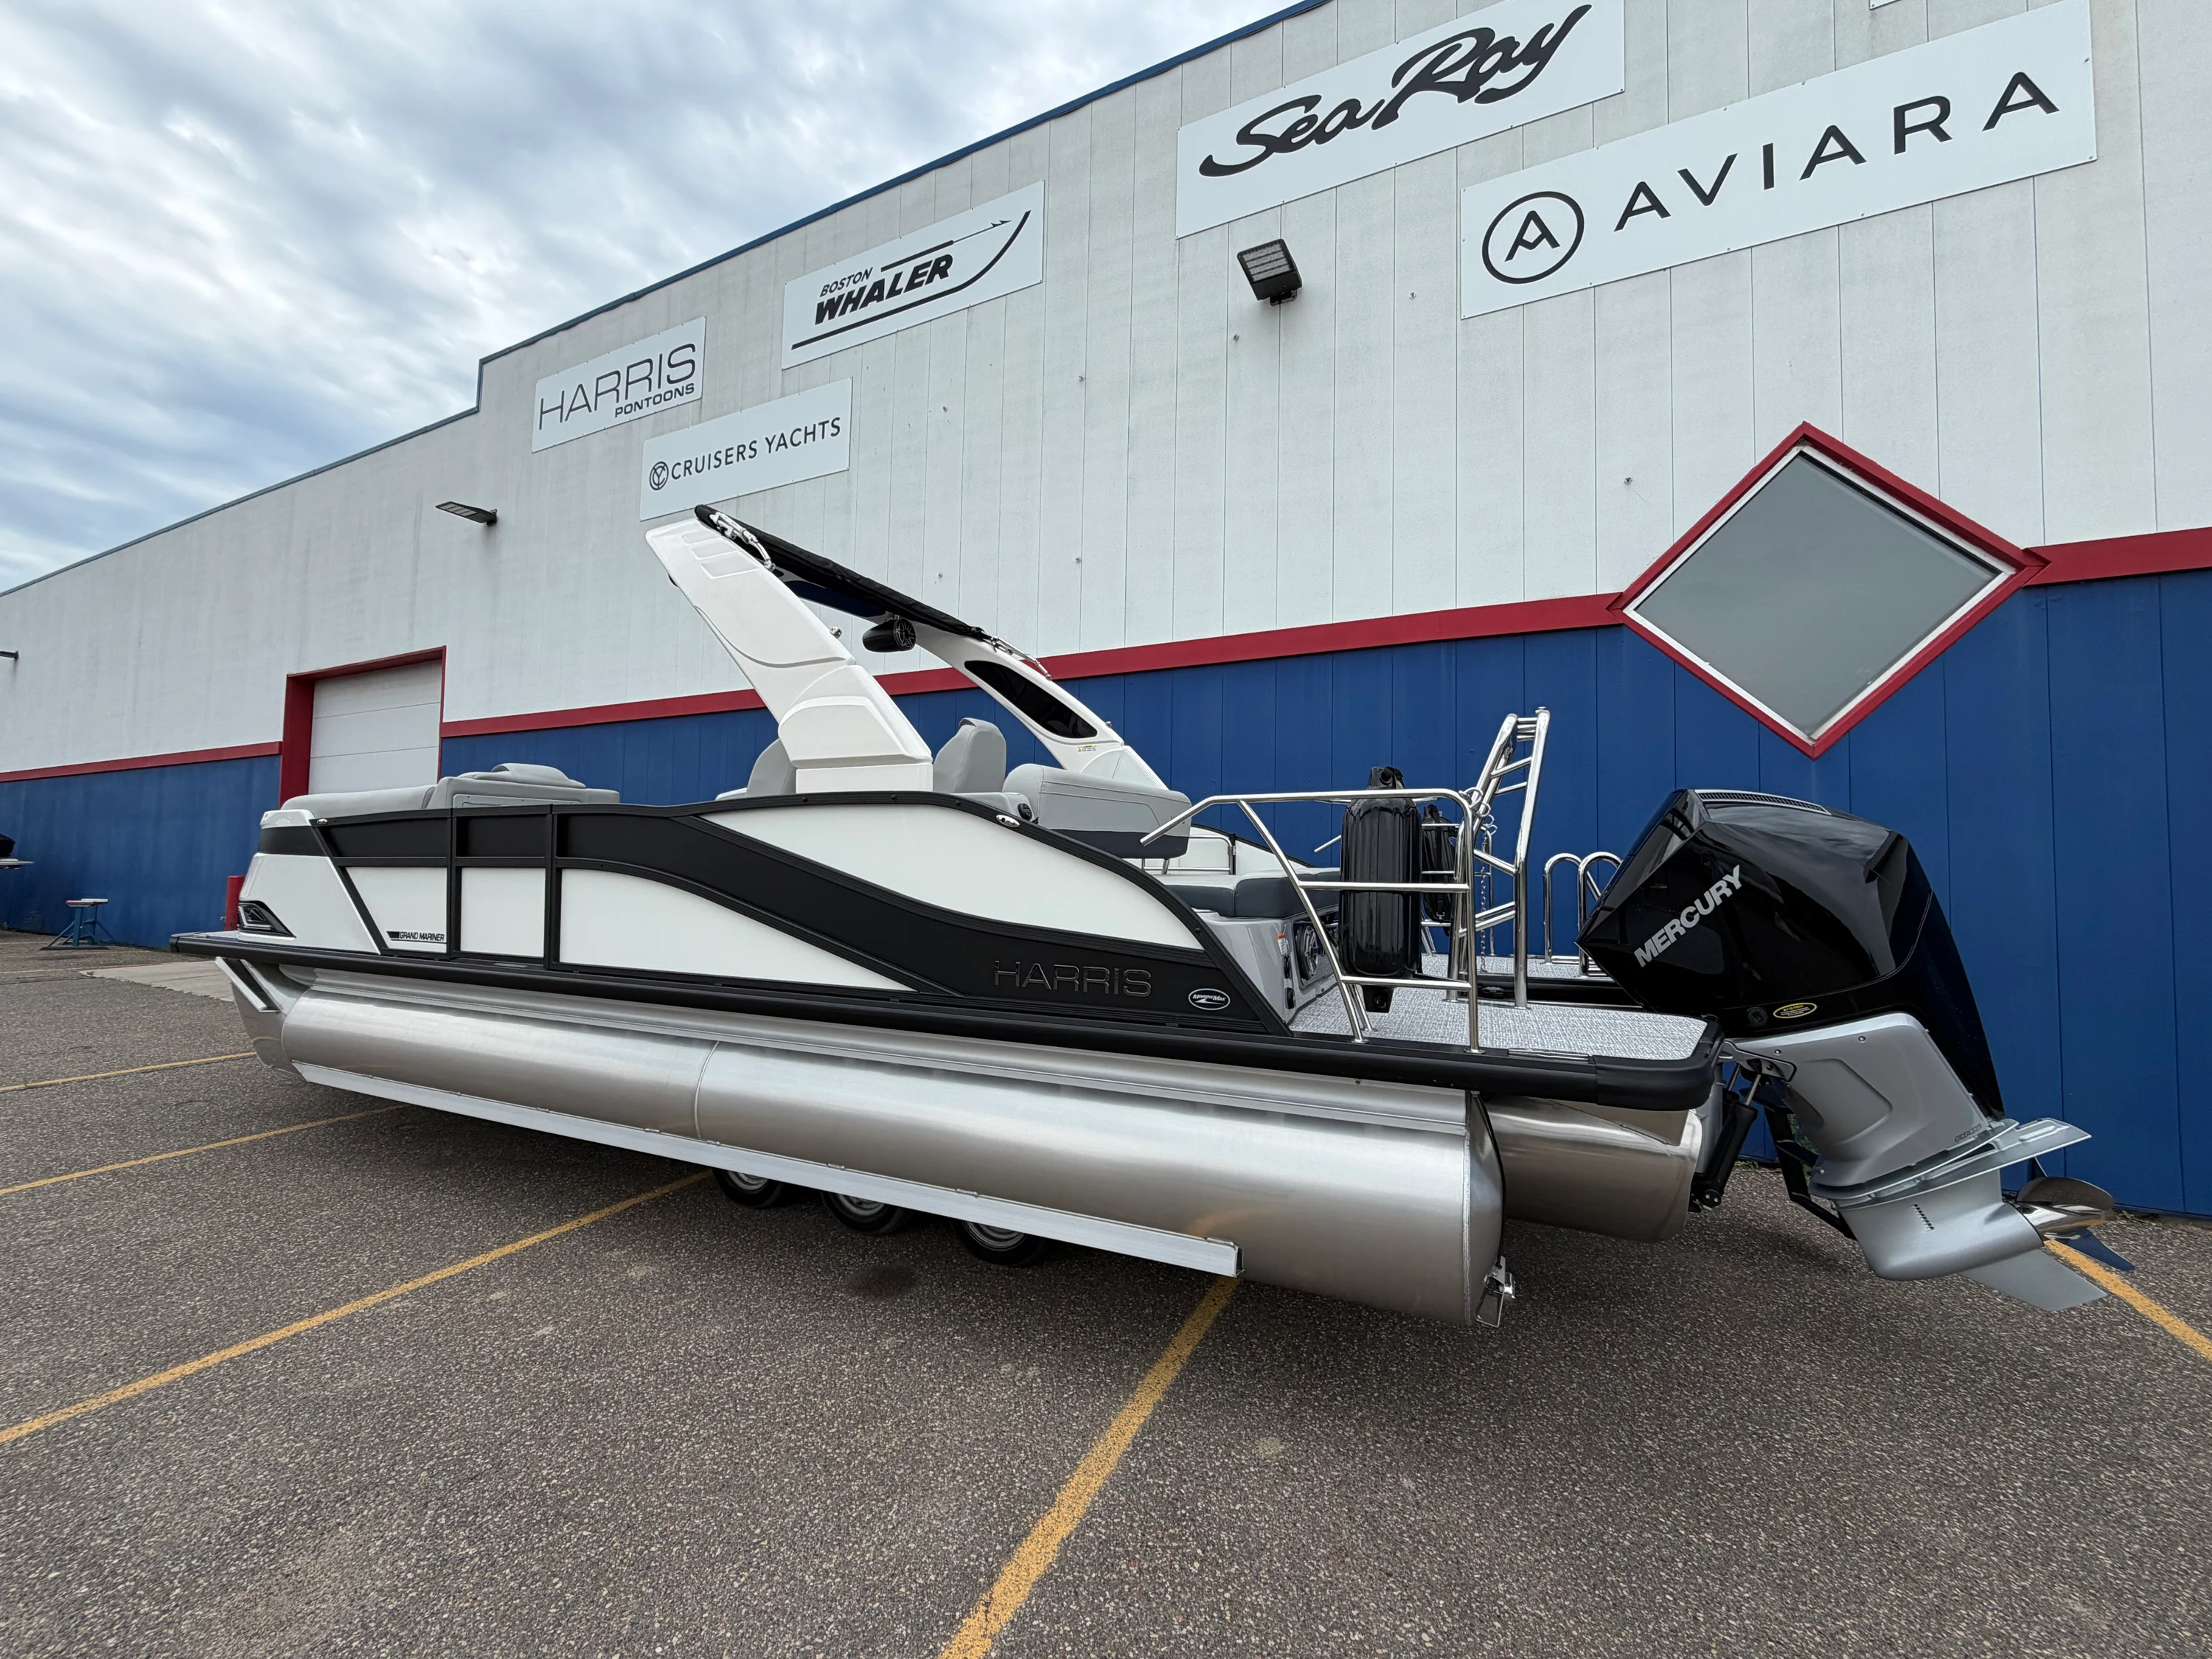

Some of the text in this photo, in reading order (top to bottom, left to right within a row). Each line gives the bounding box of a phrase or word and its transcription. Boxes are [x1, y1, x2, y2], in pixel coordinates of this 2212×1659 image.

[1199, 4, 1592, 176] Sea Ray
[1614, 72, 2059, 232] AVIARA
[815, 254, 953, 325] WHALER
[820, 267, 873, 297] BOSTON
[539, 344, 696, 430] HARRIS
[615, 383, 695, 417] PONTOONS
[671, 440, 757, 479] CRUISERS
[765, 417, 841, 453] YACHTS
[400, 931, 445, 942] GRAND MARINER
[1634, 864, 1742, 967] MERCURY
[994, 961, 1152, 997] HARRIS
